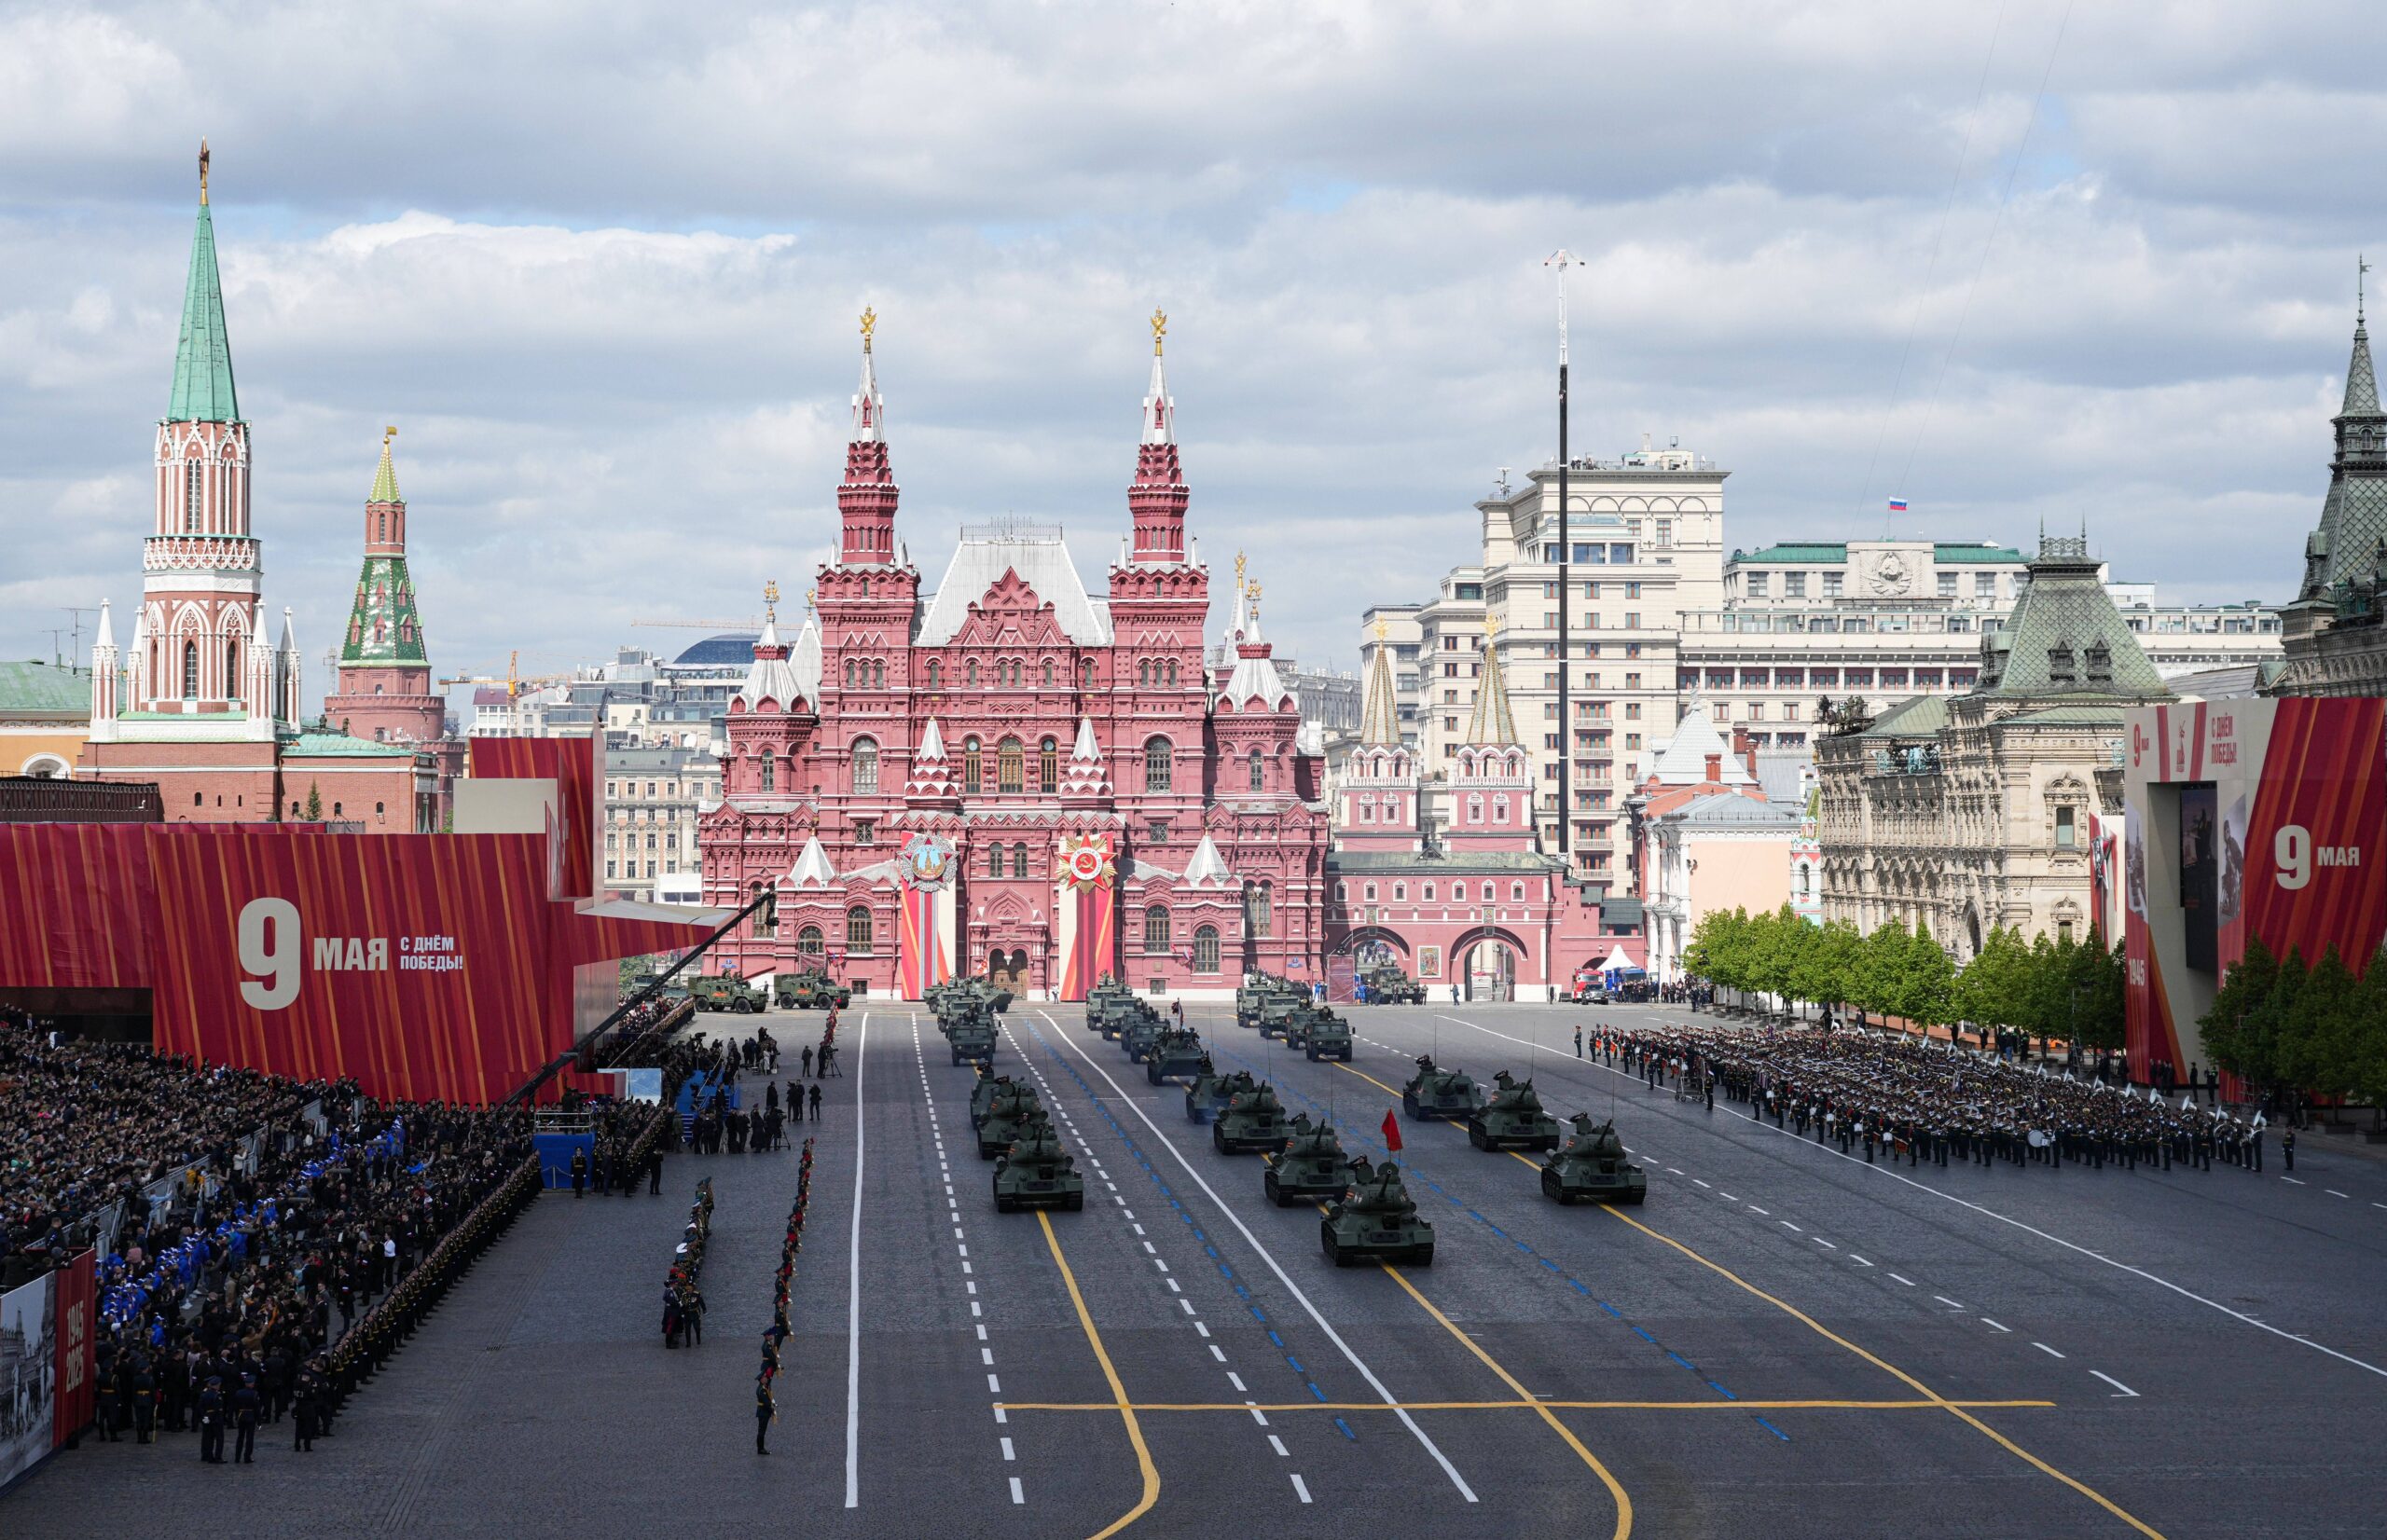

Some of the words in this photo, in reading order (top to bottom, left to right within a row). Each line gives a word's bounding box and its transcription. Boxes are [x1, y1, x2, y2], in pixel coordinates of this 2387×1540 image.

[2133, 723, 2141, 767] 9
[2274, 825, 2311, 890] 9
[2317, 846, 2360, 867] МАЯ
[238, 897, 301, 1011] 9
[313, 937, 388, 971] МАЯ
[400, 936, 409, 952] С
[413, 935, 454, 953] ДНЁМ
[400, 955, 463, 972] ПОБЕДЫ!
[66, 1299, 83, 1347] 1945
[65, 1343, 84, 1394] 2025
